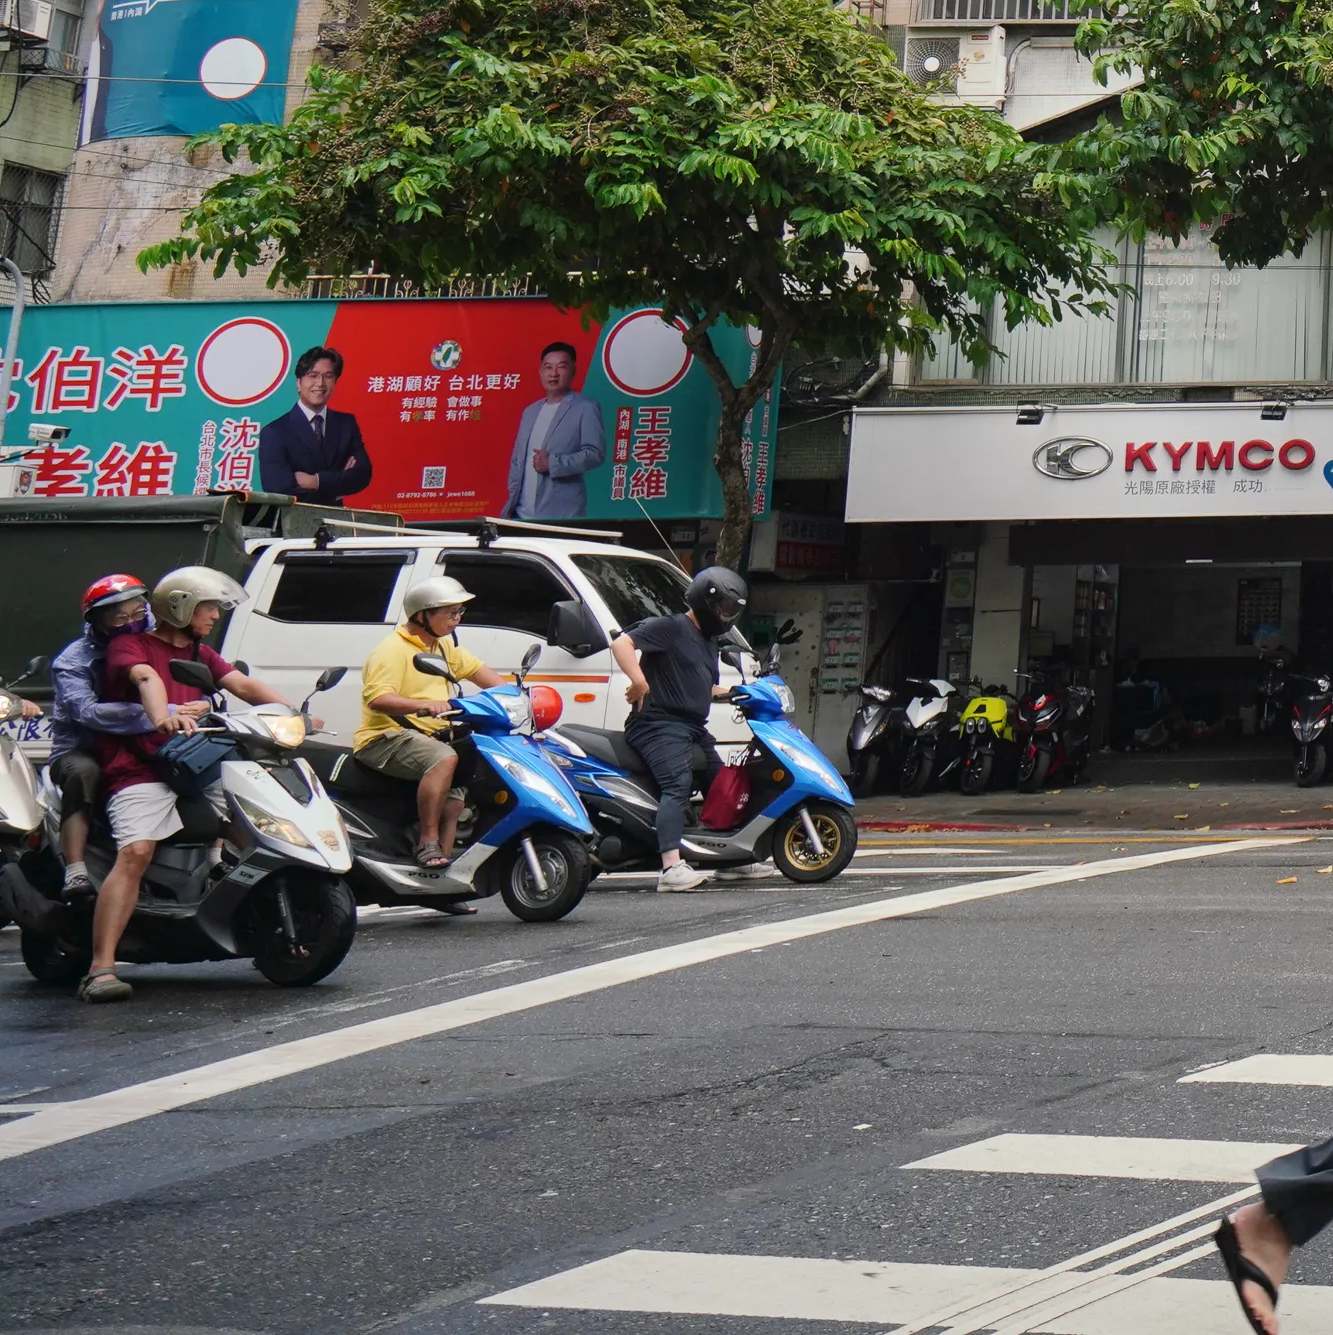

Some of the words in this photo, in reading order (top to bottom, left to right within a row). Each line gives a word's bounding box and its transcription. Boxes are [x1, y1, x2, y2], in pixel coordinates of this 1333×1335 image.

[367, 375, 441, 393] 港湖顧好
[449, 374, 520, 391] 台北更好
[402, 397, 438, 409] 有經驗
[447, 396, 482, 408] 會做事
[629, 406, 671, 499] 王孝維
[1124, 439, 1316, 472] KYMCO
[611, 464, 627, 500] 市議員
[1124, 479, 1216, 496] 光陽原廠授權
[239, 870, 255, 879] SYM
[409, 871, 440, 879] PGO
